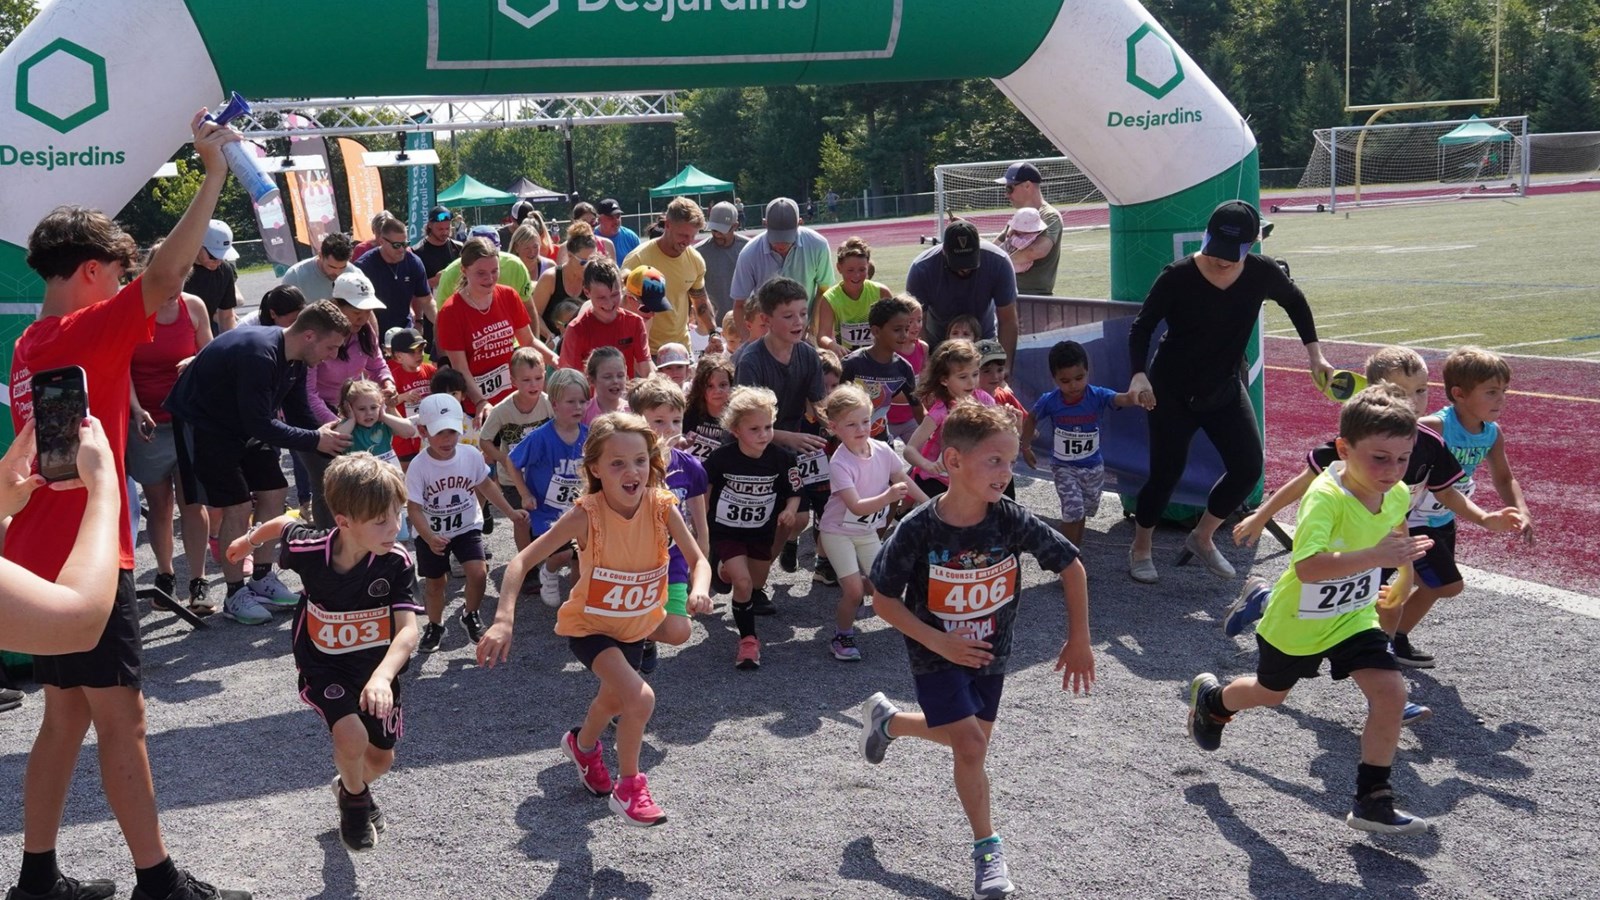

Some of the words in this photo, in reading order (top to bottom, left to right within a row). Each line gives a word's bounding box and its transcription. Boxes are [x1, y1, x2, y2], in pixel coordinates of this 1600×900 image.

[1107, 107, 1203, 131] Desjardins
[0, 145, 126, 171] Desjardins
[409, 138, 420, 239] Desjards
[472, 330, 483, 340] LA
[849, 328, 871, 341] 172
[479, 374, 503, 396] 130
[691, 443, 713, 458] 22
[1062, 440, 1094, 454] 154
[800, 460, 820, 478] 24
[727, 504, 766, 521] 363
[430, 513, 463, 532] 314
[609, 573, 636, 582] COURSE
[935, 569, 943, 577] LA
[946, 571, 974, 580] COURSE
[603, 580, 660, 610] 405
[945, 576, 1007, 612] 406
[1318, 575, 1371, 609] 223
[318, 611, 342, 621] COURSE
[346, 612, 368, 621] BRYAN
[368, 608, 385, 618] LIEW
[318, 621, 380, 647] 403
